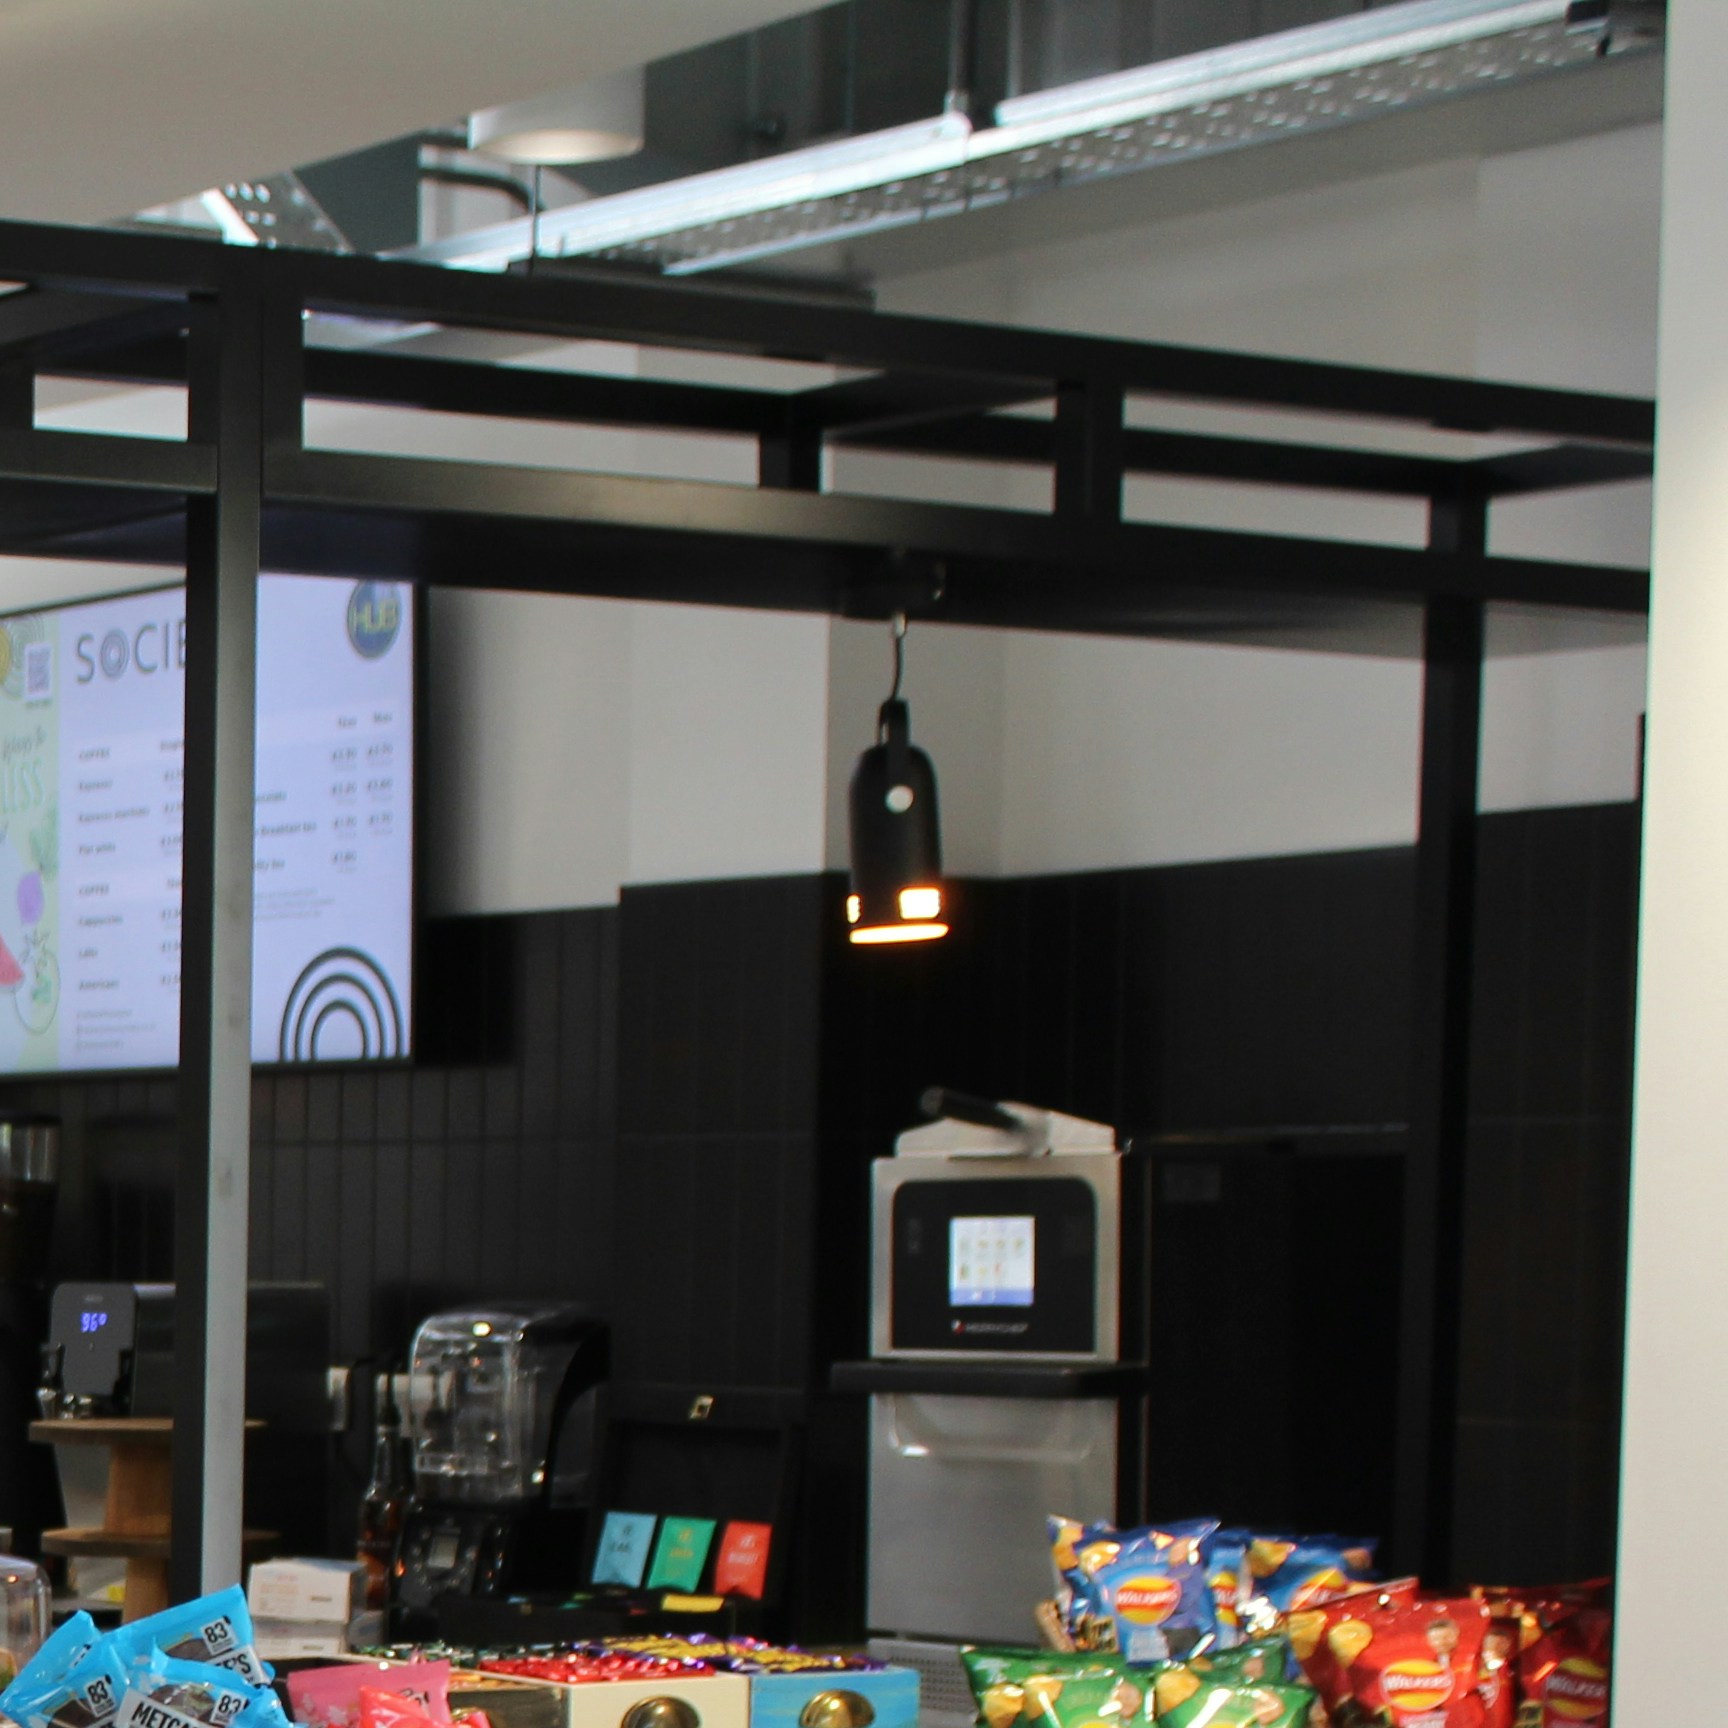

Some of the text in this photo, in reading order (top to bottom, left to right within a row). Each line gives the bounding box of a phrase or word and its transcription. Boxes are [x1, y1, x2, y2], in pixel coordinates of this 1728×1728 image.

[348, 598, 398, 636] HUB
[204, 1620, 228, 1644] 83
[92, 1680, 110, 1703] 83
[217, 1694, 243, 1716] 83
